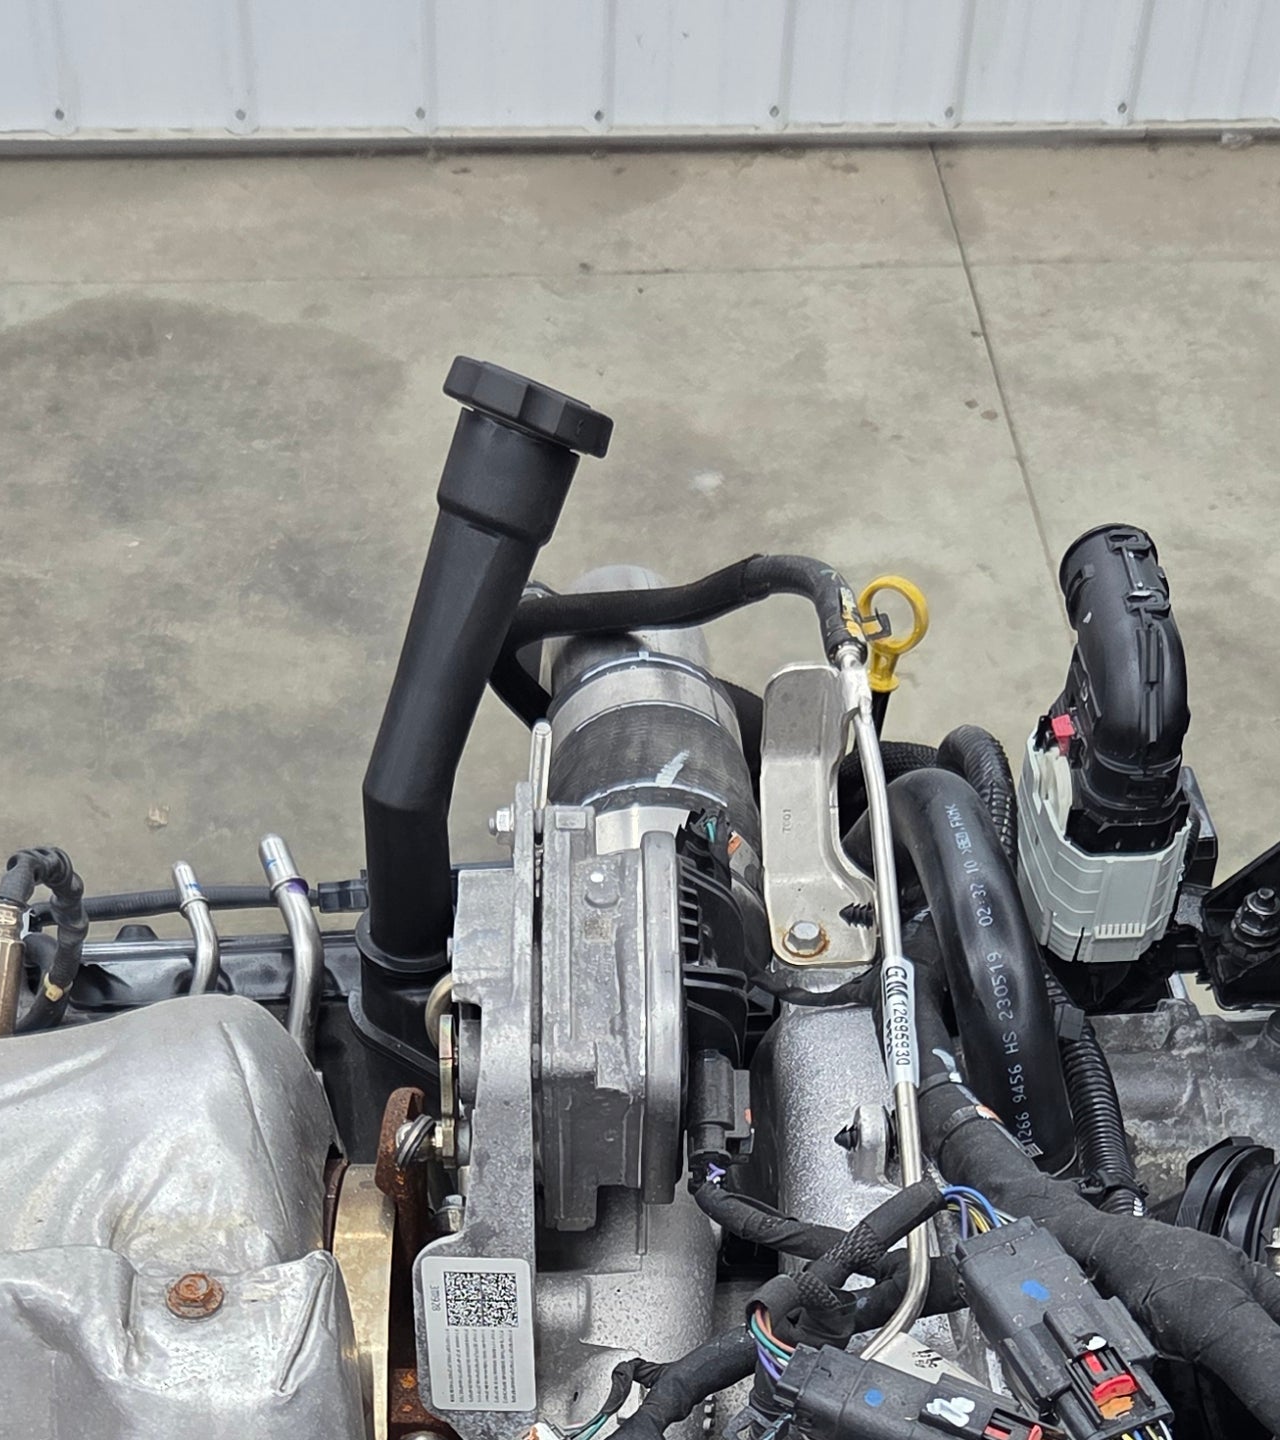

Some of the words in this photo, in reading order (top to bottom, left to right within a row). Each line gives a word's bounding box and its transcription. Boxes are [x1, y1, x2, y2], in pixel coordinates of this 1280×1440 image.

[885, 965, 909, 999] GM
[986, 951, 1014, 1021] 230519
[893, 1000, 911, 1066] 12695930
[1002, 1031, 1019, 1054] HS
[1008, 1063, 1027, 1103] 9456
